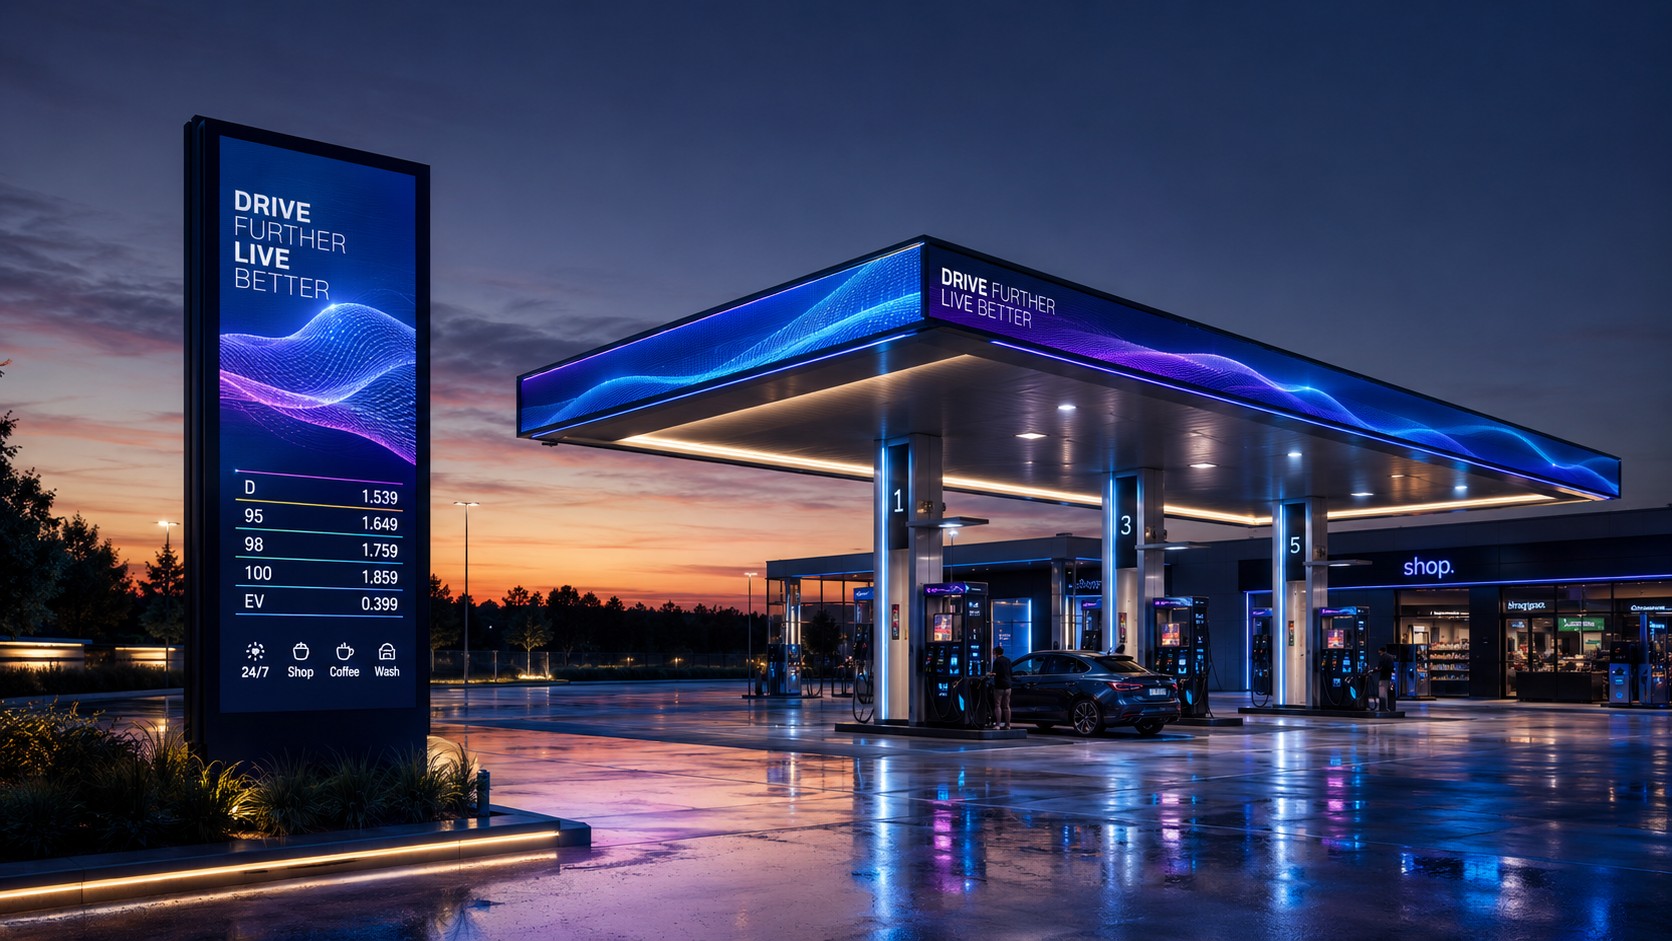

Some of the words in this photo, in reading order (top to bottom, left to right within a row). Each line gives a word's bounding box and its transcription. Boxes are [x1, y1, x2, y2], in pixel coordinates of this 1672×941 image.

[234, 189, 311, 224] DRIVE
[234, 215, 347, 254] FURTHER
[234, 240, 290, 270] LIVE
[235, 267, 330, 300] BETTER
[941, 267, 988, 297] DRIVE
[991, 282, 1056, 315] FURTHER
[941, 288, 973, 313] LIVE
[977, 298, 1032, 329] BETTER
[244, 479, 256, 495] D
[362, 489, 398, 505] 1.539
[894, 488, 904, 513] 1
[244, 508, 264, 523] 95
[362, 515, 398, 531] 1.649
[1120, 515, 1132, 536] 3
[244, 536, 264, 552] 98
[362, 542, 398, 558] 1.759
[1290, 536, 1301, 554] 5
[244, 565, 273, 581] 100
[362, 569, 398, 585] 1.859
[1403, 556, 1455, 579] shop.
[244, 593, 265, 609] EV
[361, 596, 398, 611] 0.399
[241, 665, 270, 679] 24/7
[287, 665, 314, 680] Shop
[329, 665, 360, 678] Coffee
[374, 665, 400, 678] Wash
